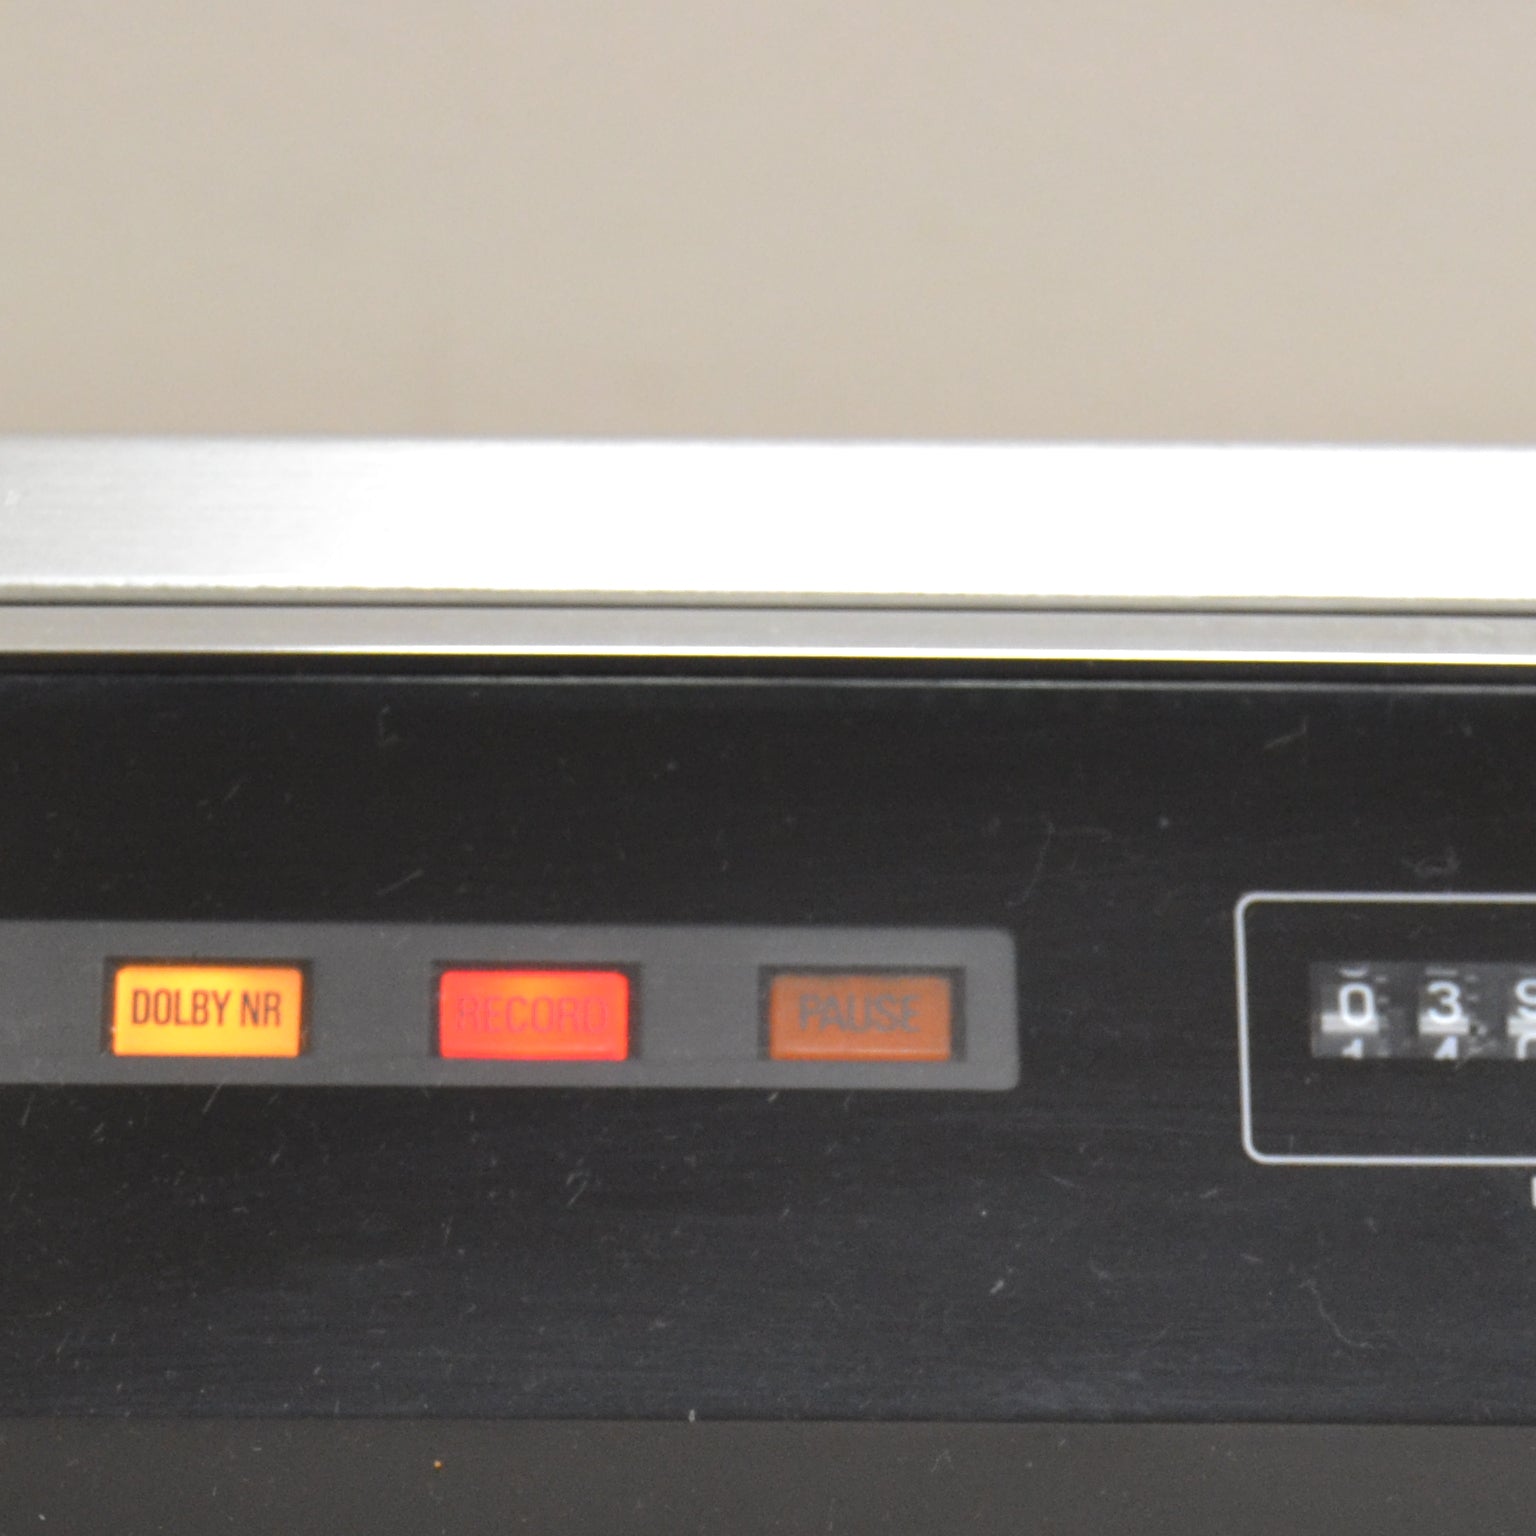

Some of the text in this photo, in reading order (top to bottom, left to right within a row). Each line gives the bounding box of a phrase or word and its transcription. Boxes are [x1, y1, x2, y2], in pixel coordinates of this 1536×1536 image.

[131, 988, 282, 1029] DOLBY NR
[455, 996, 608, 1035] RECORD
[799, 993, 922, 1034] PAUSE
